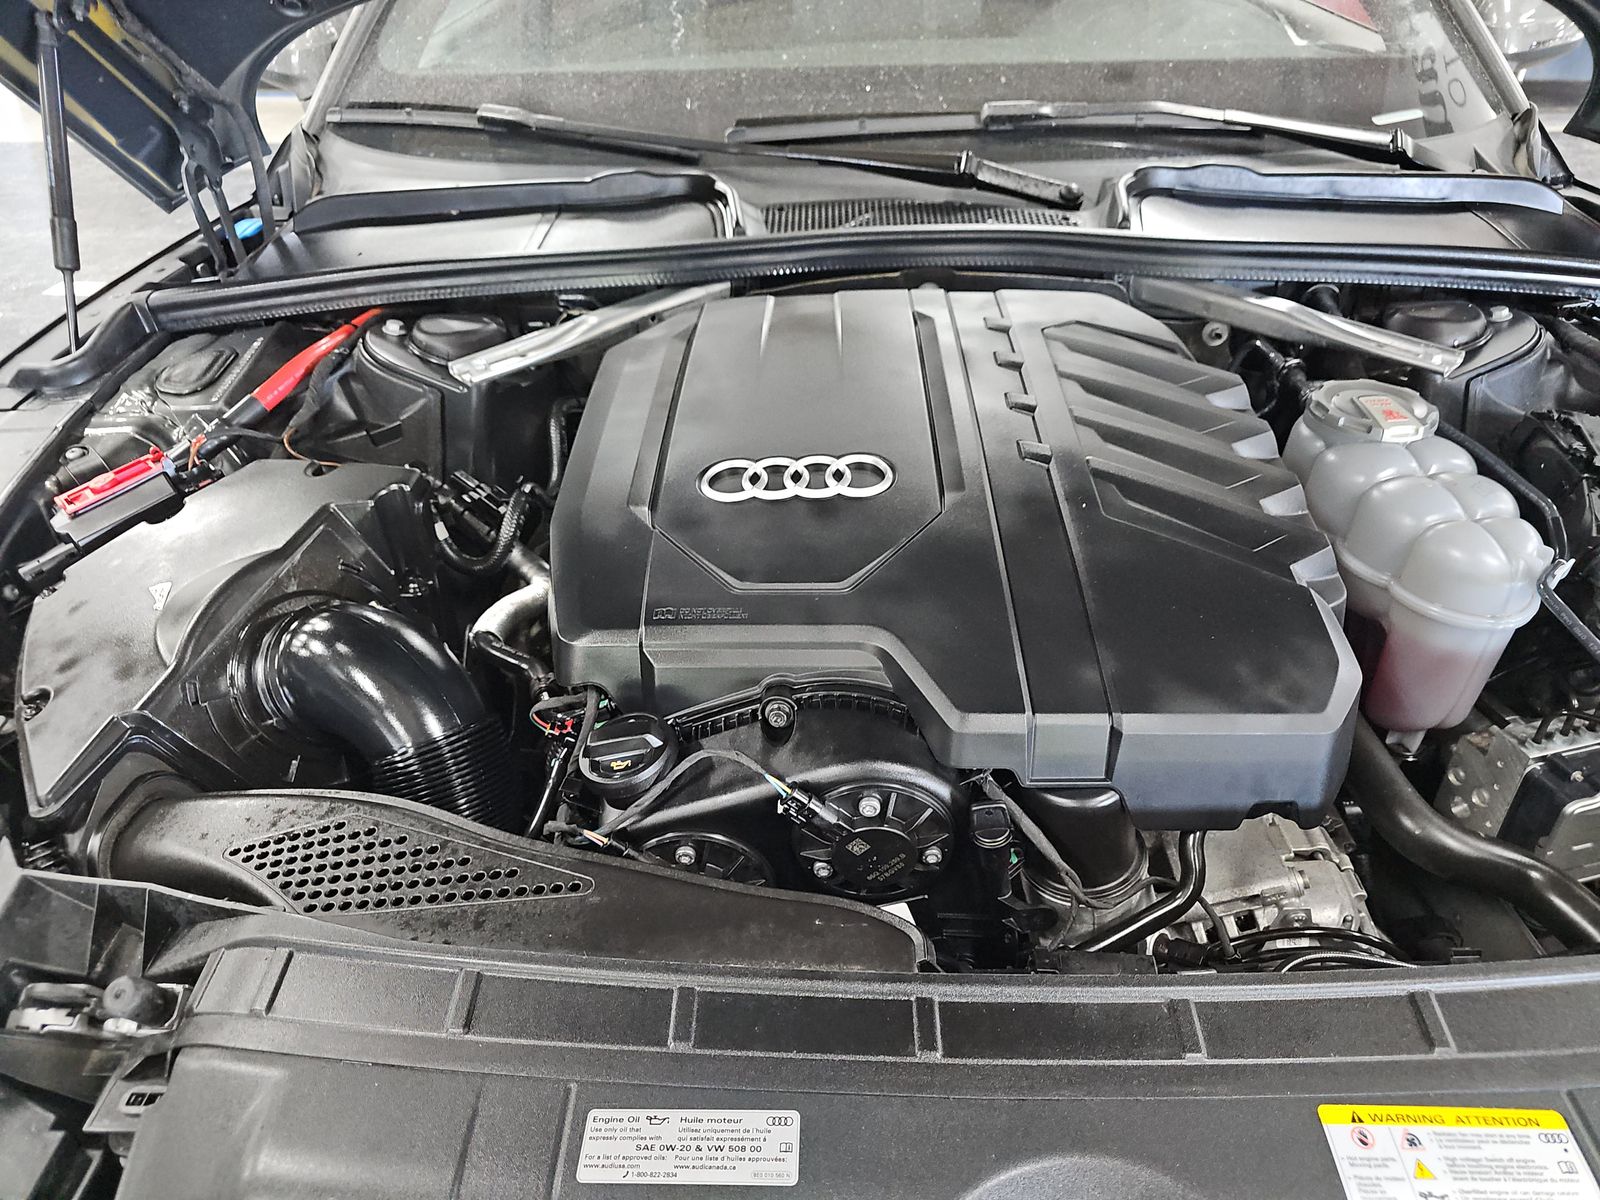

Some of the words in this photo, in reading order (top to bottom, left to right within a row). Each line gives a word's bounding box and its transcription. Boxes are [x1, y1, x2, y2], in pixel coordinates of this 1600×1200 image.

[592, 1116, 624, 1124] Engine
[680, 1116, 704, 1124] Huile
[1368, 1113, 1445, 1124] WARNING
[1455, 1115, 1540, 1127] ATTENTION
[635, 1144, 656, 1152] SAE
[659, 1144, 692, 1152] 0W-20
[749, 1145, 762, 1153] 00
[622, 1154, 652, 1162] approved
